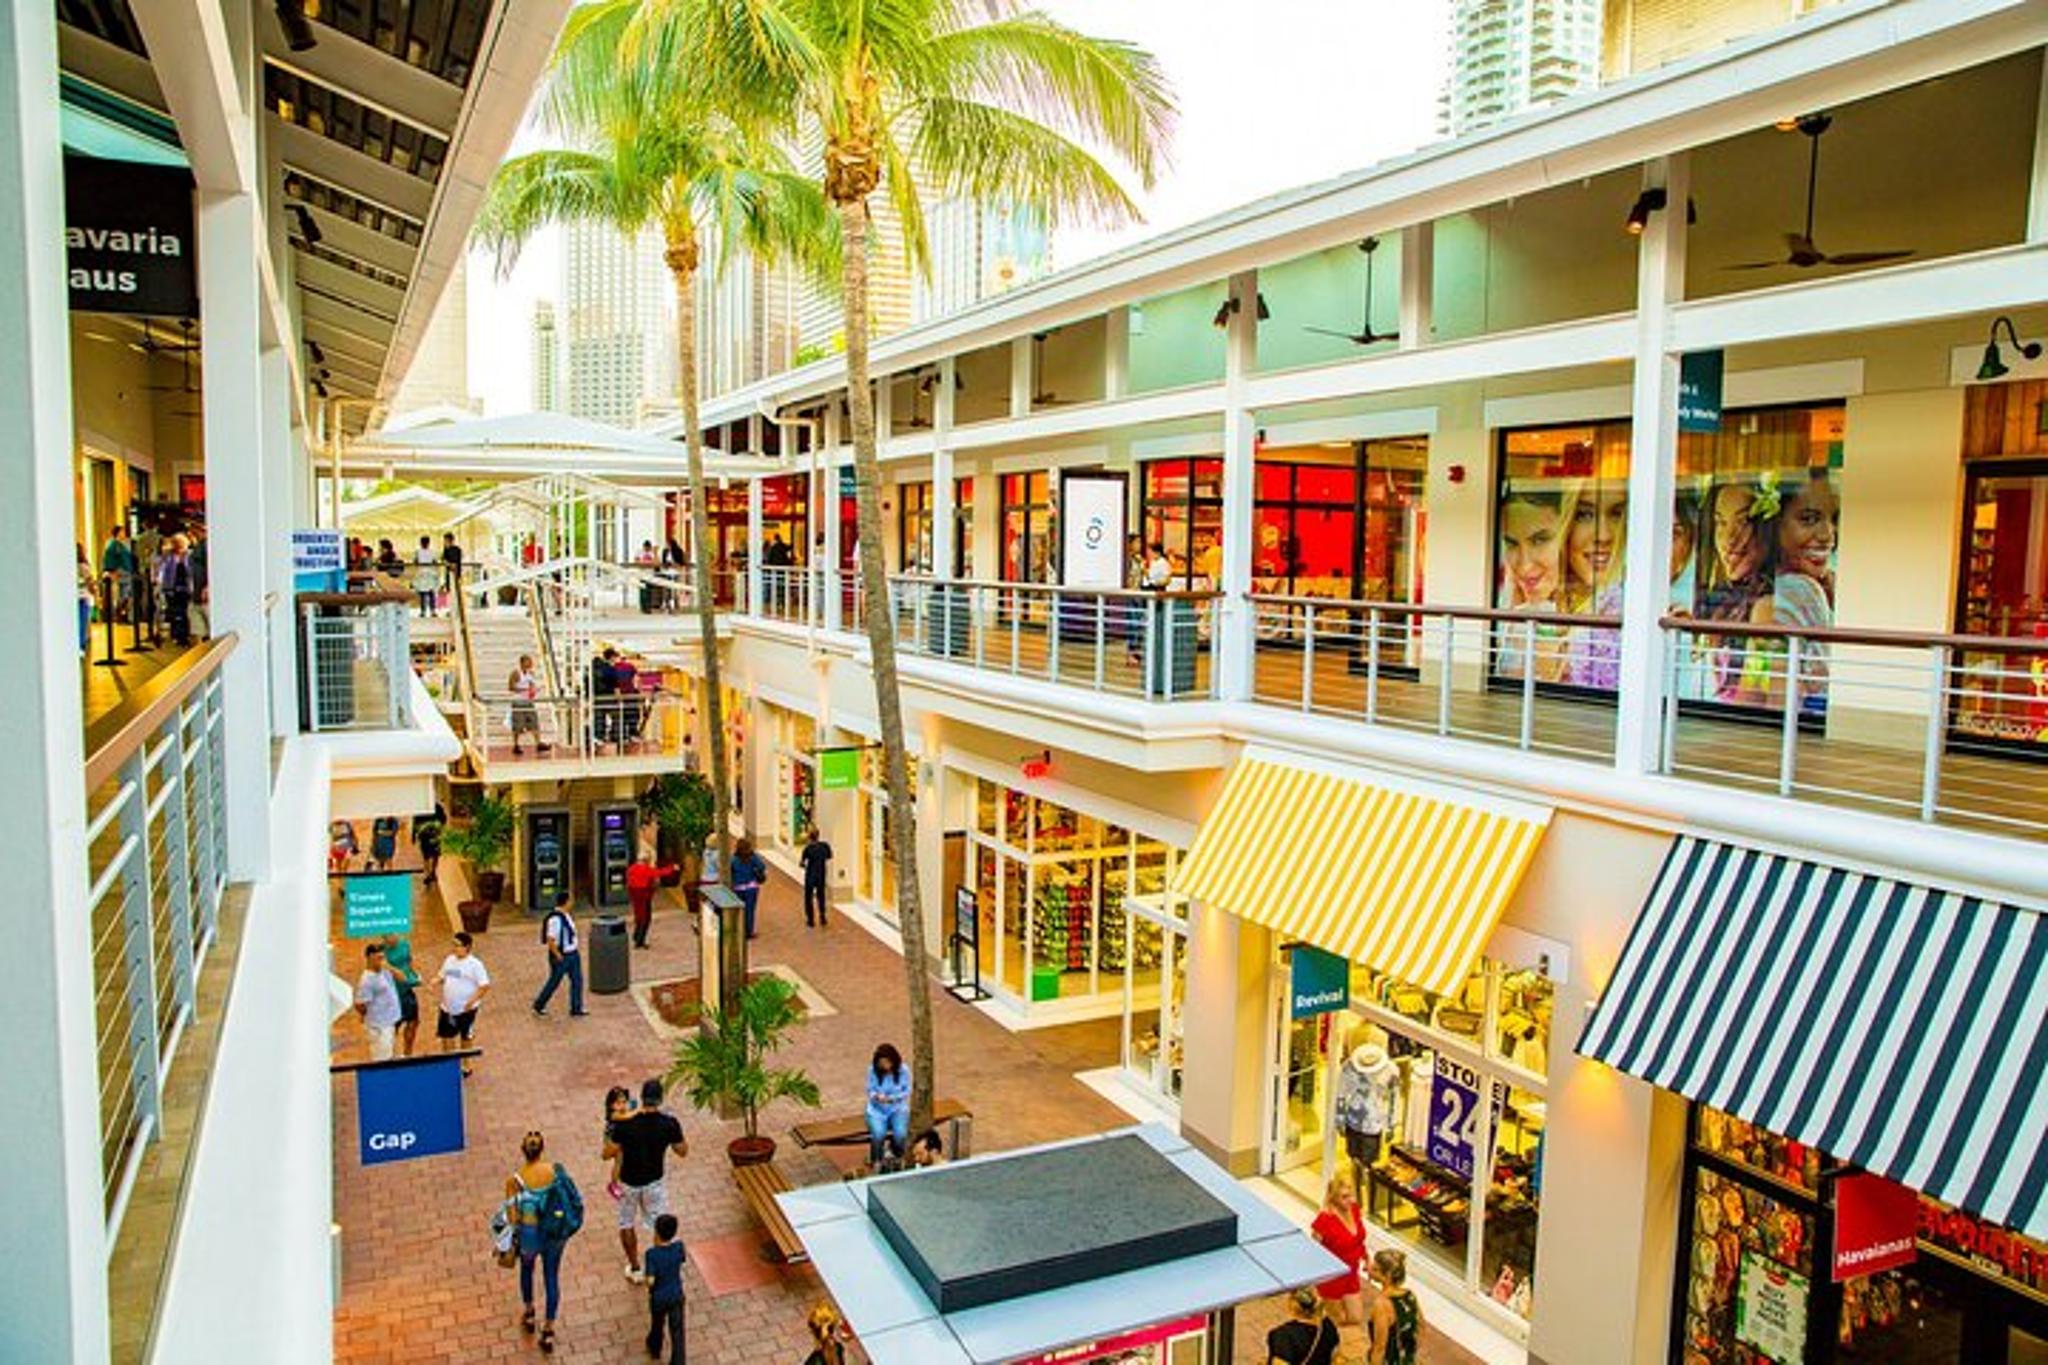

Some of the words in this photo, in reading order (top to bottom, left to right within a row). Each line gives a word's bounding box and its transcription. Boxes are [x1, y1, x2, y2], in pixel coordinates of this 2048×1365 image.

[70, 267, 138, 294] aus
[349, 905, 393, 917] Square
[1296, 986, 1343, 1008] Revival
[369, 1131, 416, 1150] Gap
[1837, 1236, 1912, 1268] Havaianas
